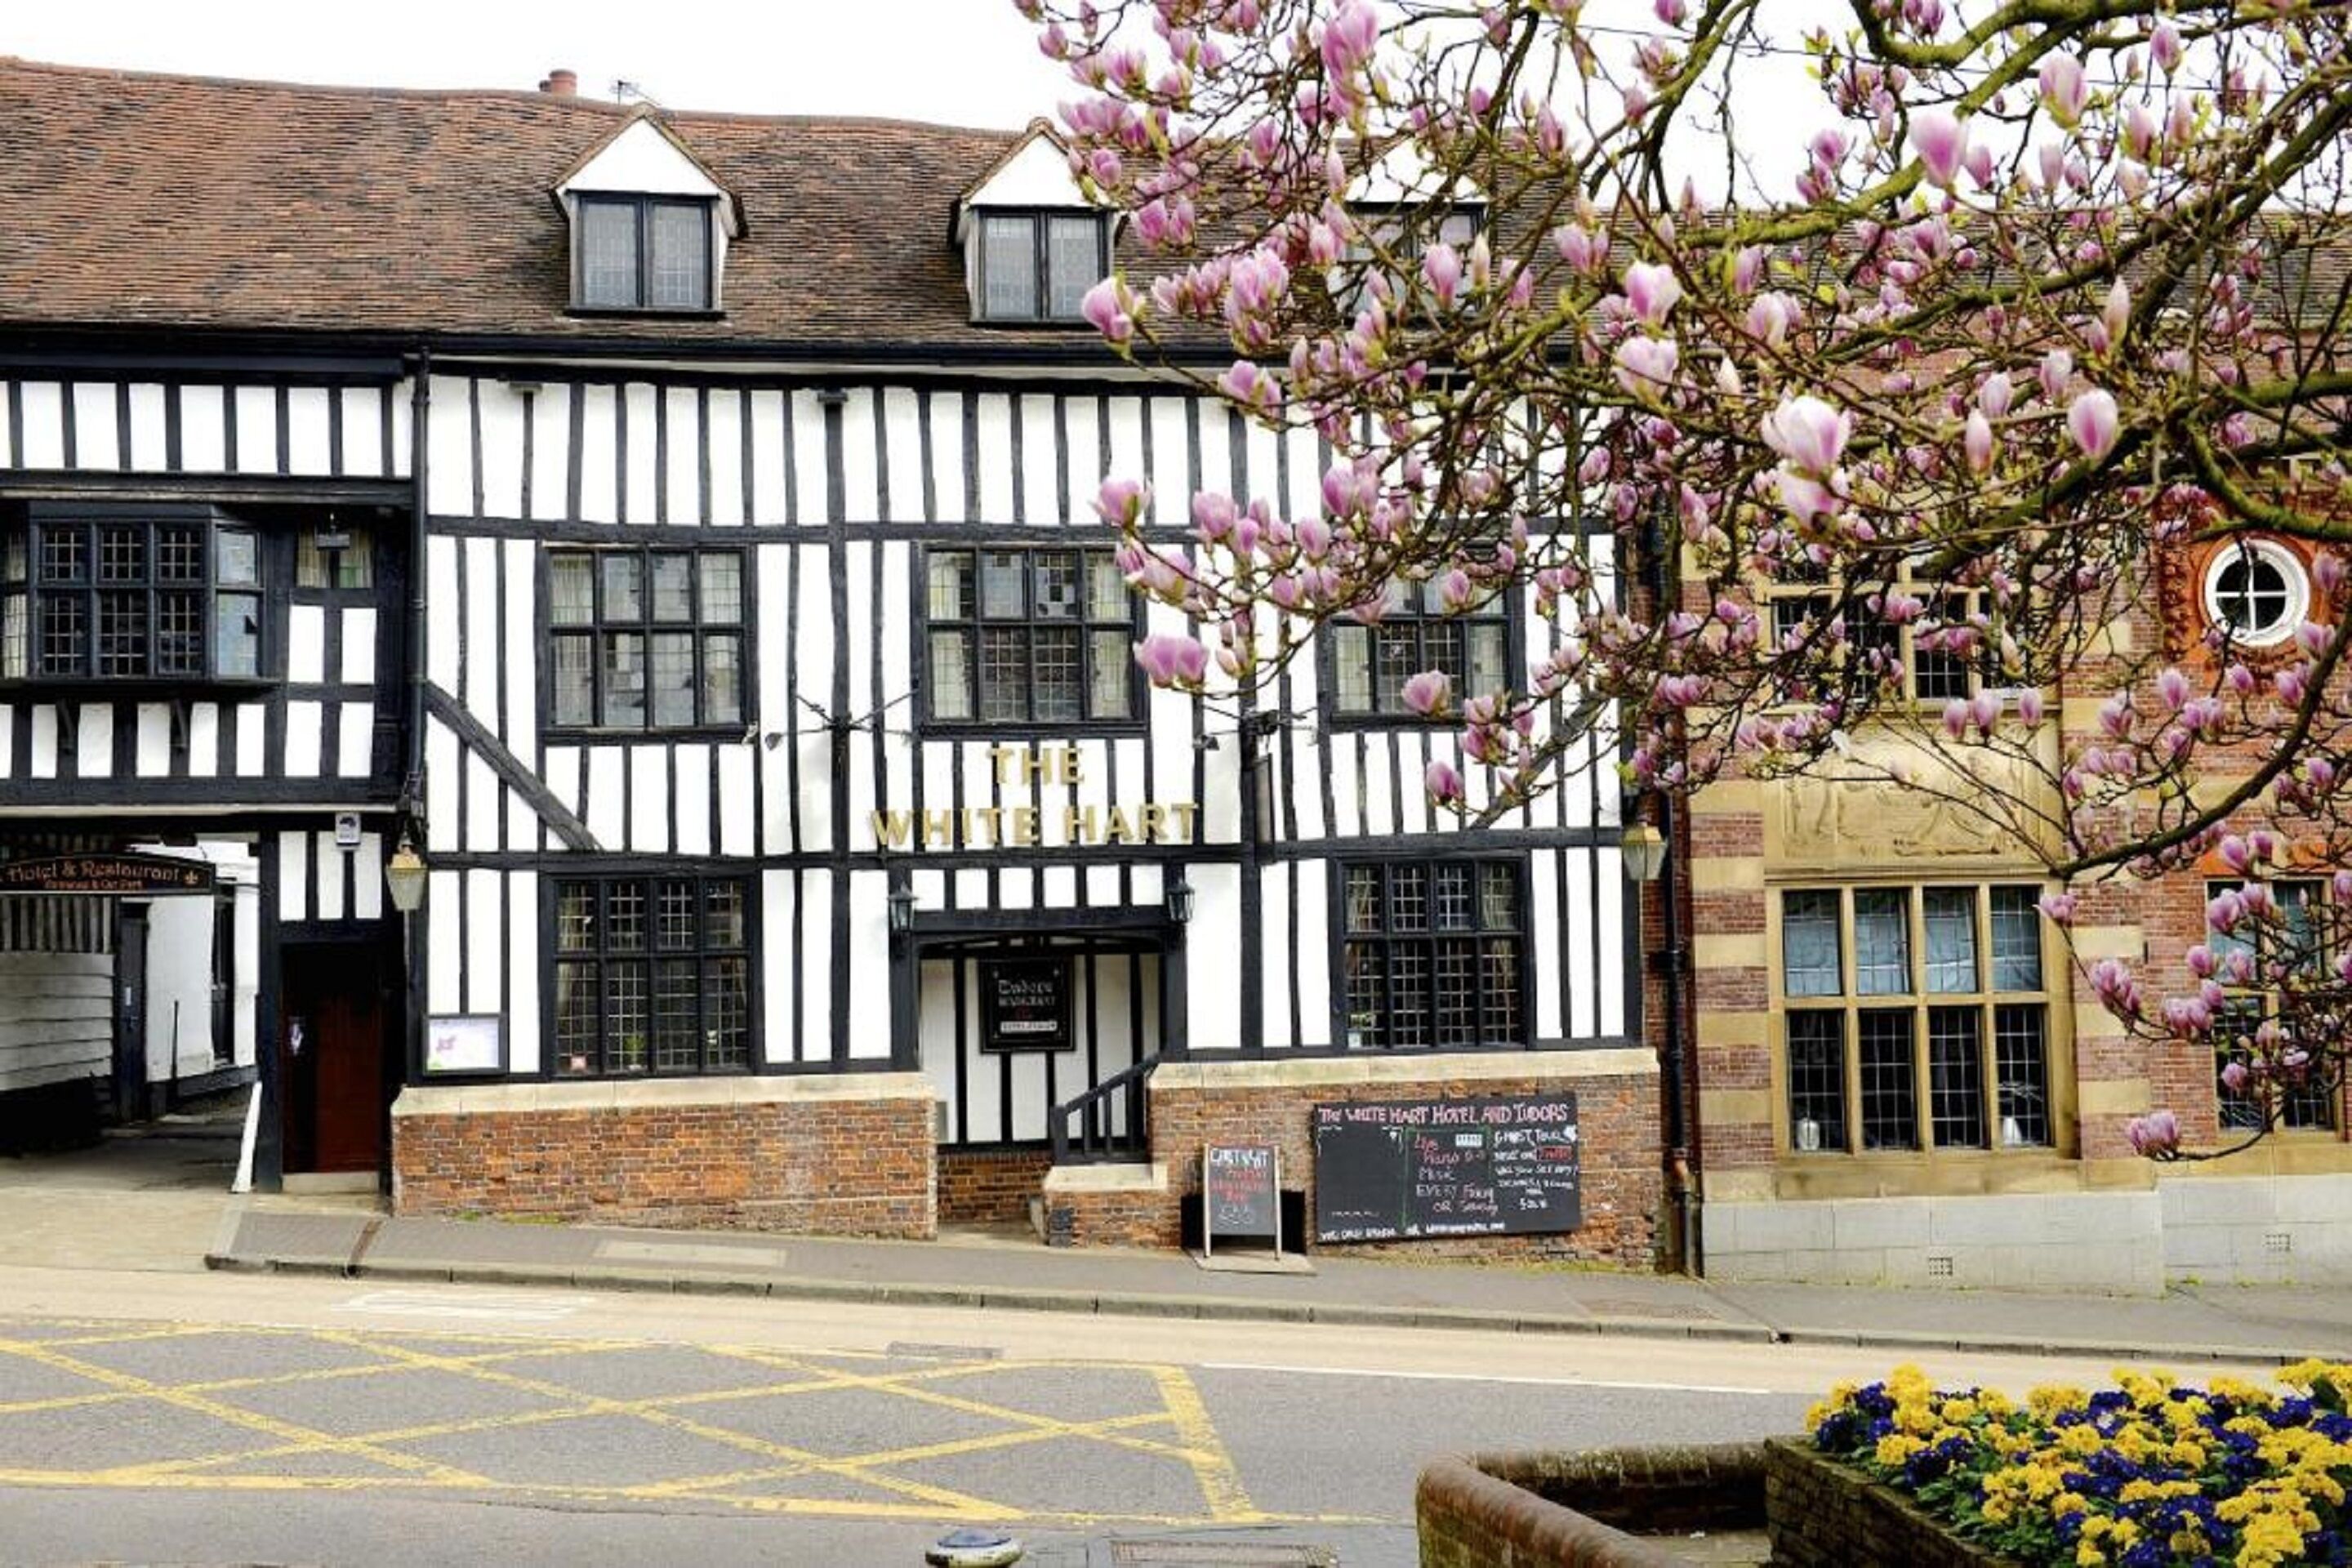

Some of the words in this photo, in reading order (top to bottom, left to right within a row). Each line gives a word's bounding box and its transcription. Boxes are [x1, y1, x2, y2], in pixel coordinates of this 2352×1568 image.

[988, 746, 1085, 785] THE
[870, 807, 1040, 846] WHITE
[1064, 803, 1198, 843] HART
[8, 863, 58, 883] Hotel
[1346, 1107, 1387, 1122] WHITE
[1390, 1105, 1429, 1125] HART
[1432, 1103, 1479, 1125] HOTEL
[1481, 1104, 1512, 1124] AND
